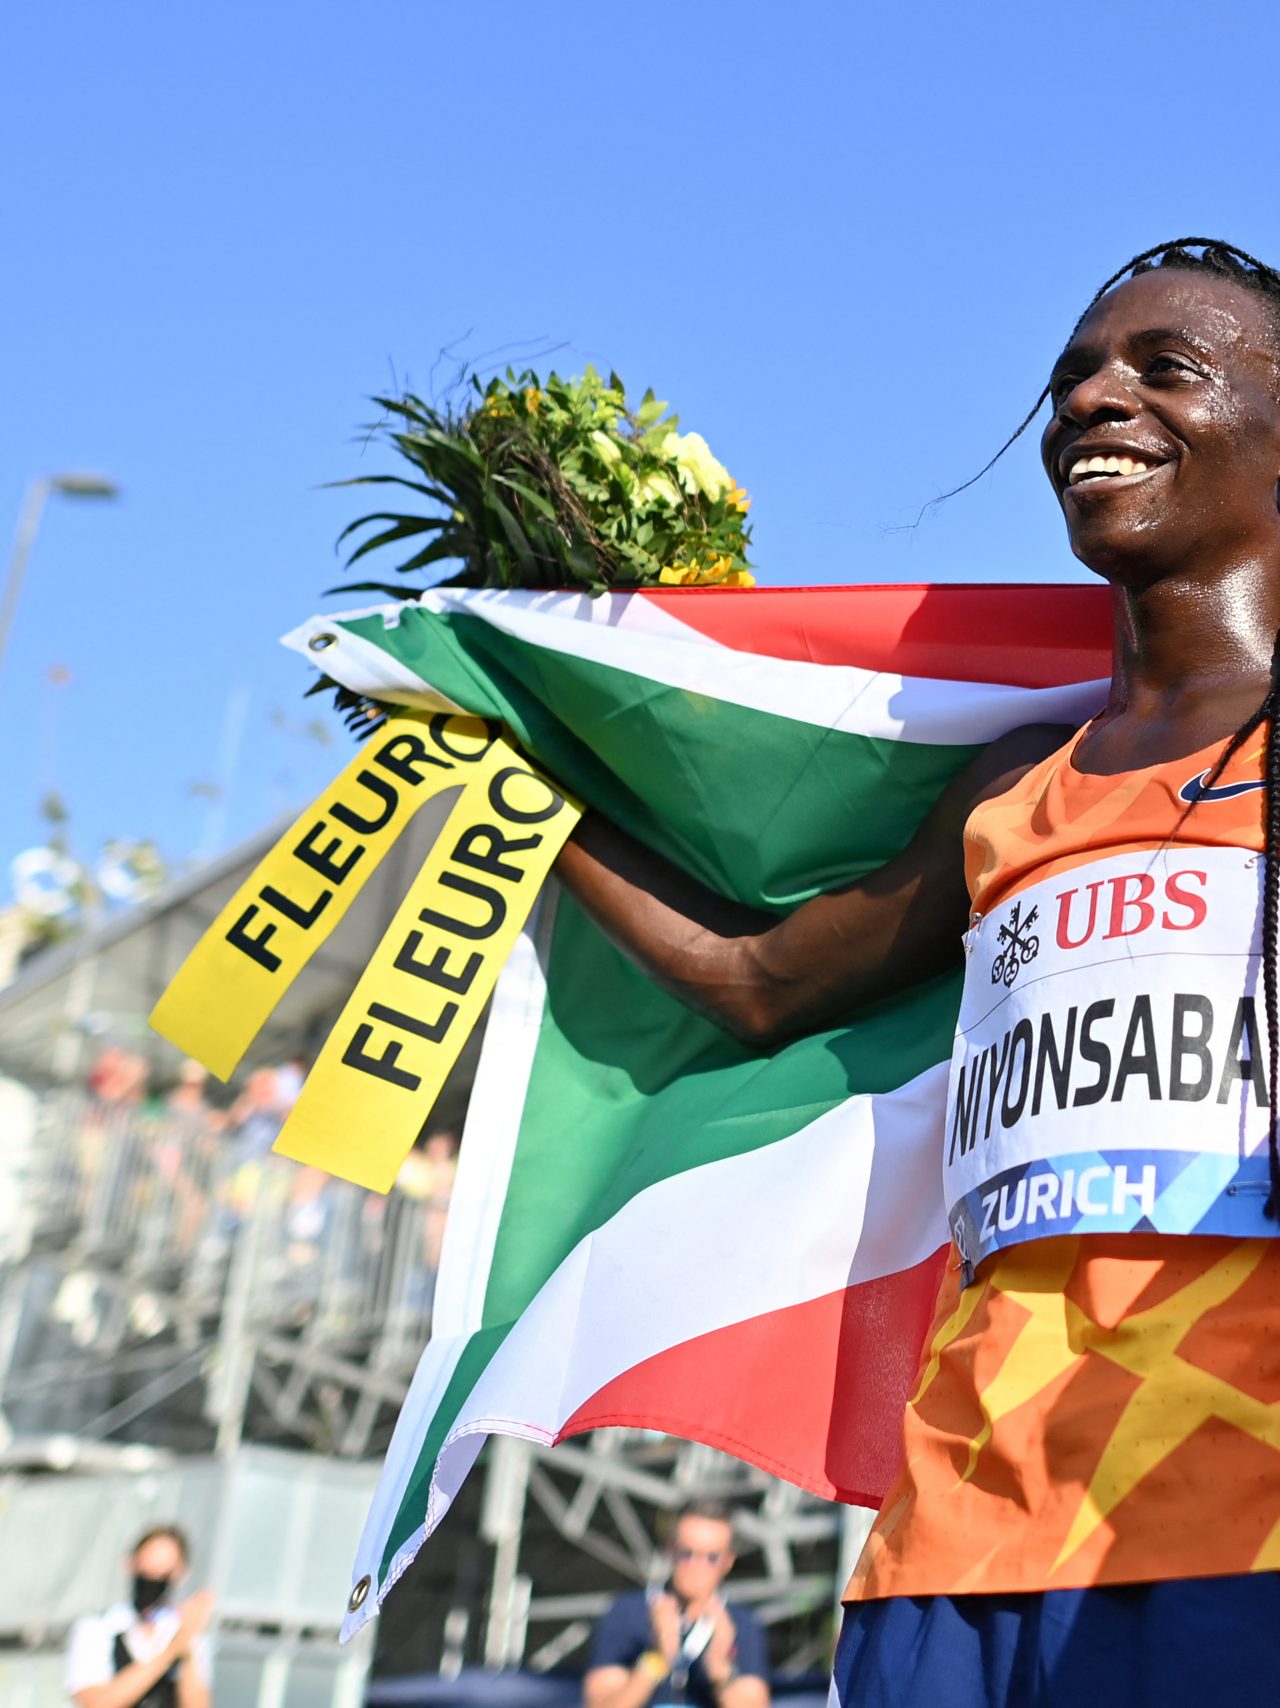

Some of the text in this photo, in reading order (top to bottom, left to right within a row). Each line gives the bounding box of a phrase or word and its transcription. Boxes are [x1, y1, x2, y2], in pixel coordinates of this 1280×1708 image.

[224, 711, 502, 974] FLEURO
[340, 765, 566, 1092] FLEURO
[1054, 868, 1209, 951] UBS
[947, 991, 1272, 1167] NIYONSABA
[978, 1163, 1158, 1243] ZURICH
